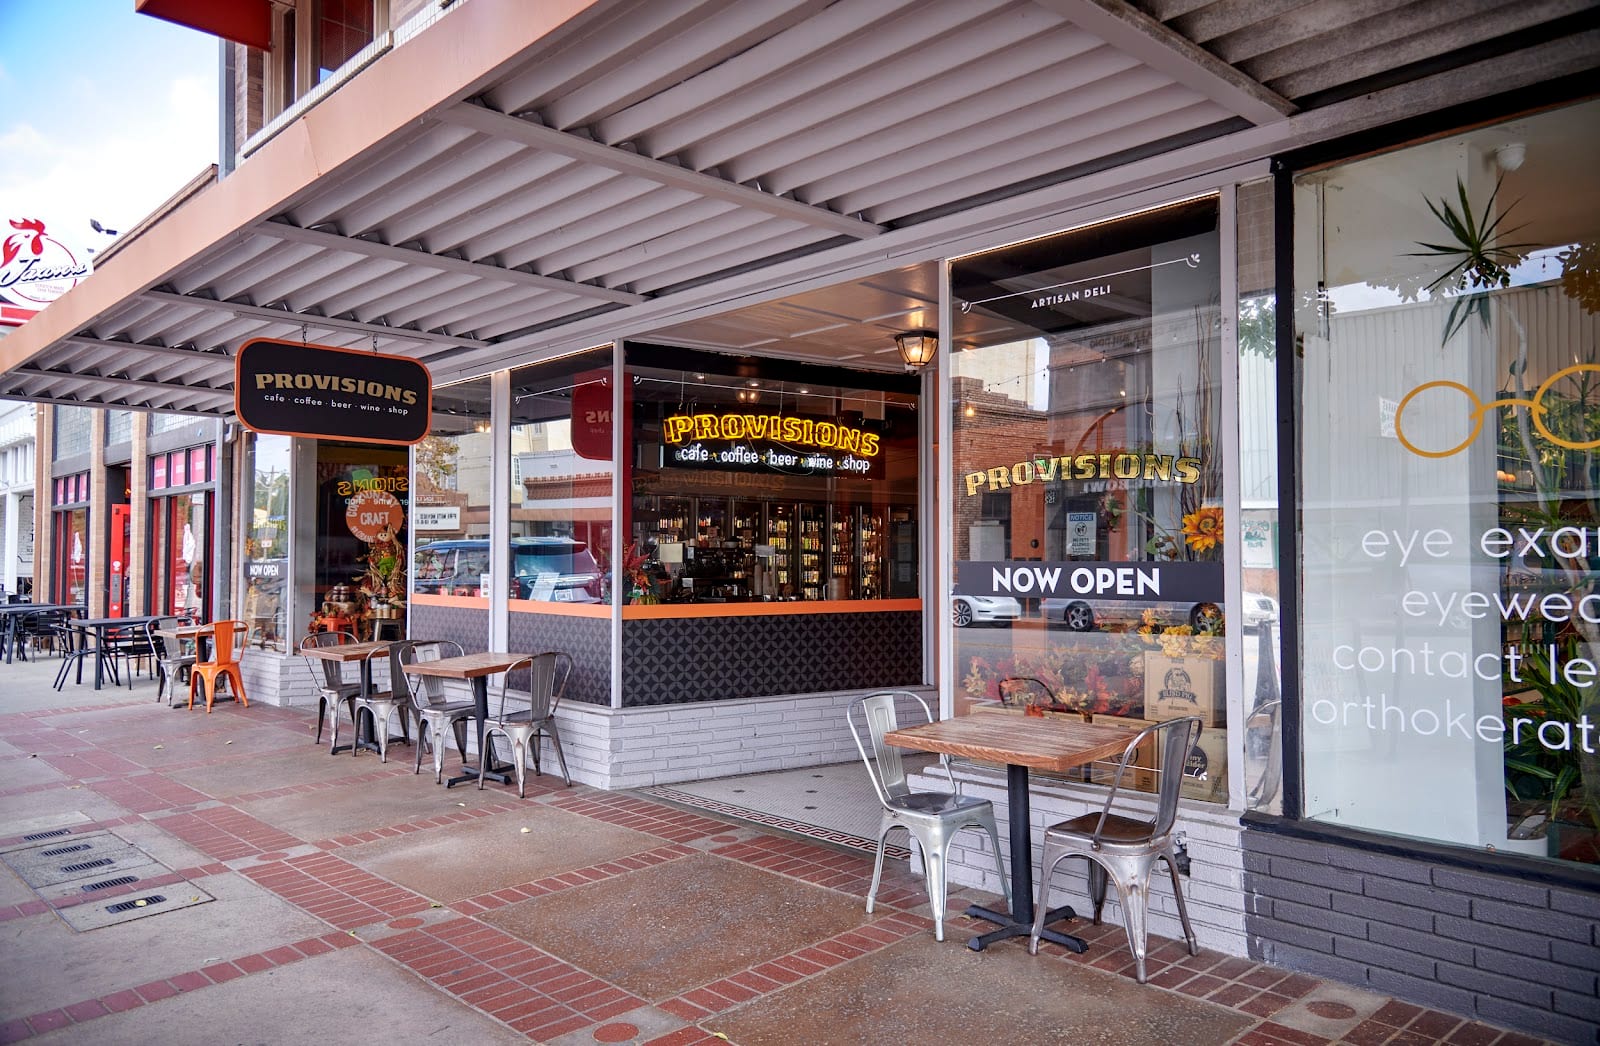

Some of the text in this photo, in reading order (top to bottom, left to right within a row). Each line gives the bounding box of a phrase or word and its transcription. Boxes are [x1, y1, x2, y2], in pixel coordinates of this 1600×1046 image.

[1031, 284, 1111, 309] ARTISAN DELI
[255, 373, 418, 406] PROVISIONS
[264, 393, 409, 416] cafe coffee beer wine shop
[665, 414, 880, 456] PROVISIONS
[679, 443, 871, 474] cafe coffee beer wine shop
[964, 453, 1202, 497] PROVISIONS
[360, 511, 390, 526] CRAFT
[1361, 528, 1453, 568] eye
[249, 564, 279, 576] NOW OPEN
[992, 566, 1160, 597] NOW OPEN
[1332, 641, 1523, 683] contact
[1311, 692, 1600, 754] orthokerat
